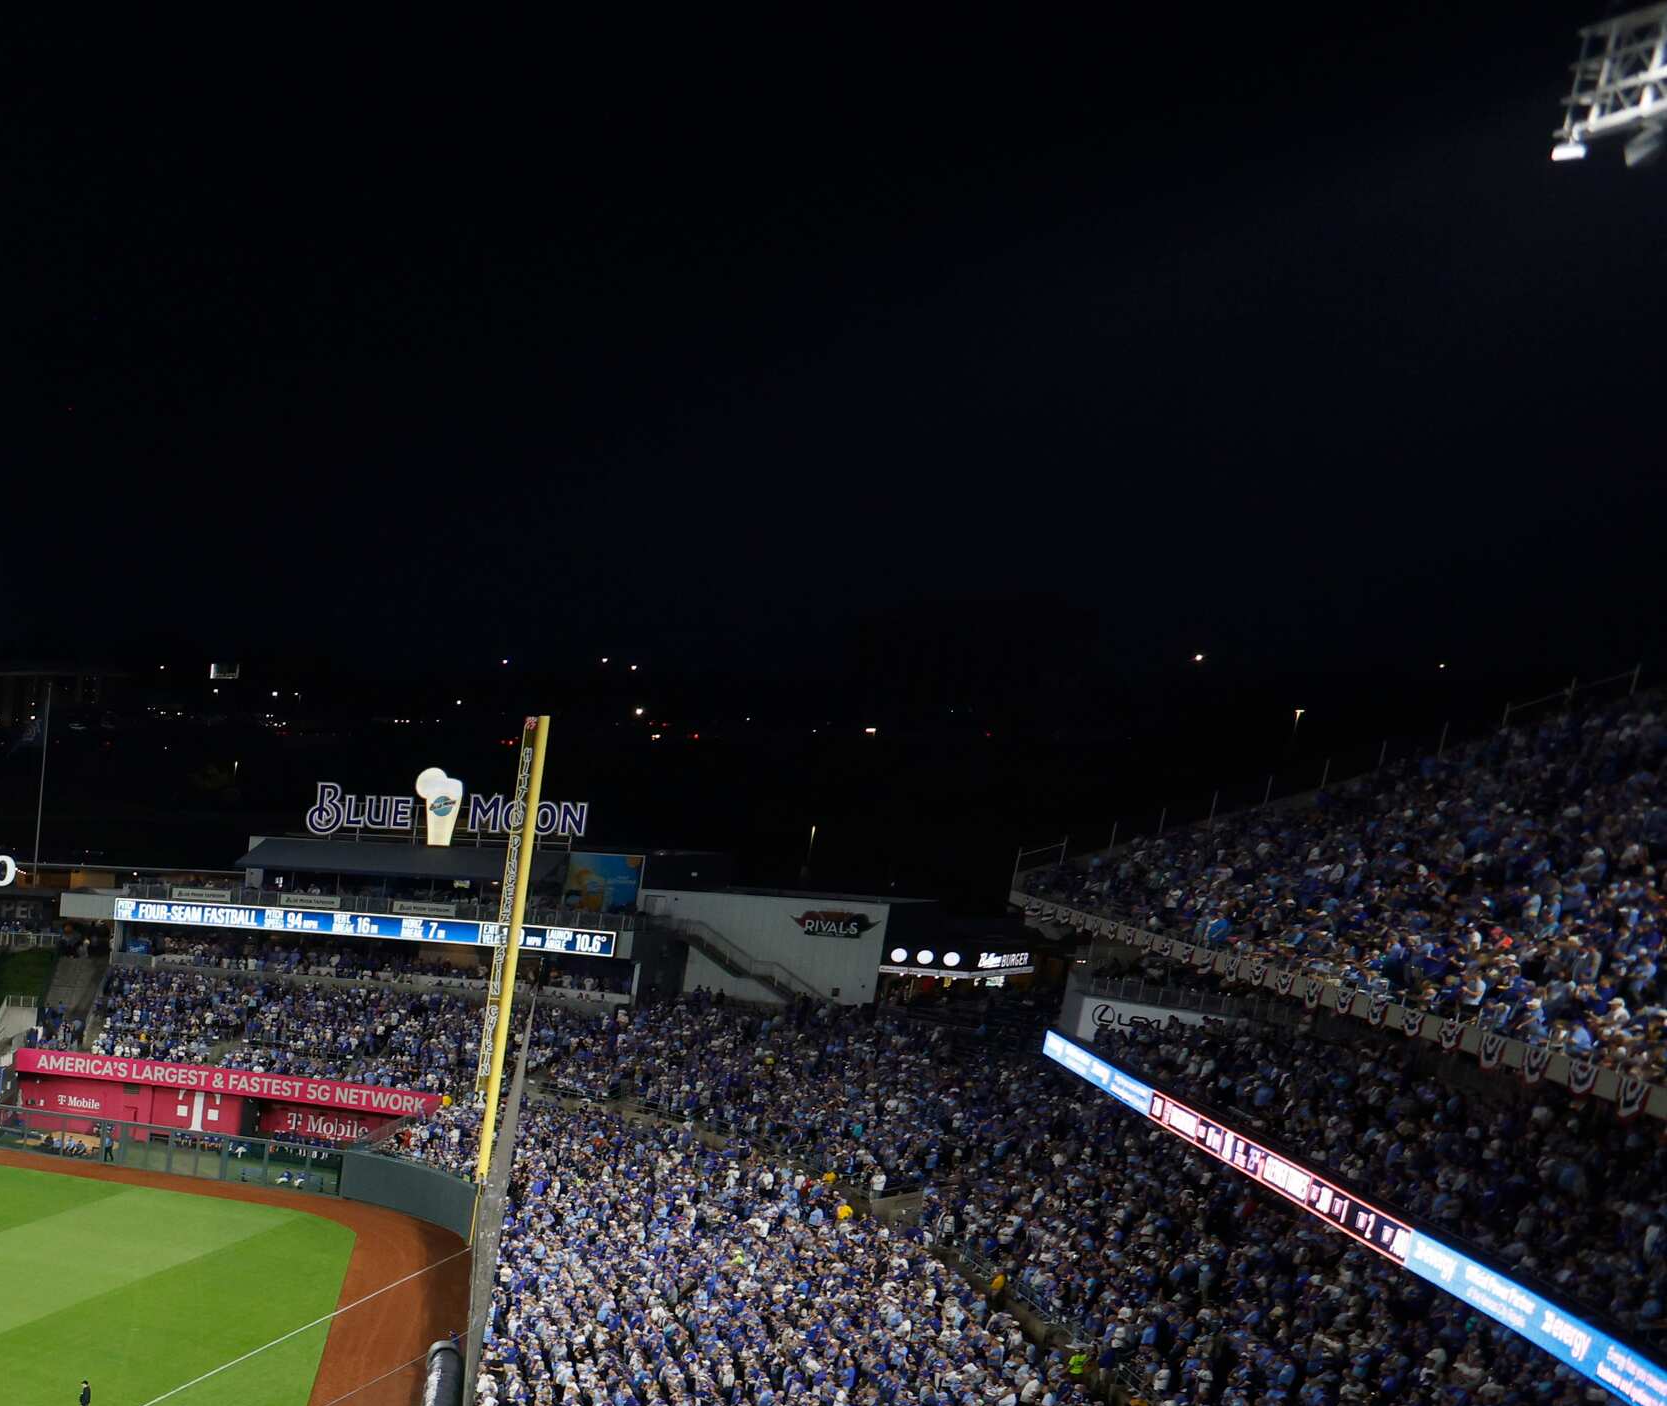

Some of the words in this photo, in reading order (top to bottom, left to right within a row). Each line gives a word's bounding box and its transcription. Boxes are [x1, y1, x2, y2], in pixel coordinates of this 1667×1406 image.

[306, 782, 413, 834] BLUE
[118, 901, 134, 910] PITCH
[139, 904, 199, 920] FOUR-SEAM
[204, 909, 257, 926] FASTBALL
[287, 912, 302, 928] 94
[357, 918, 370, 933] 16
[429, 922, 438, 938] 7
[805, 920, 858, 935] RIVALS
[546, 929, 573, 941] LAUNCH
[545, 939, 567, 950] ANGLE
[576, 934, 607, 952] 10.6°
[1001, 953, 1028, 967] BURGER
[36, 1053, 128, 1083] AMERICA'S
[131, 1065, 208, 1090] LARGEST
[212, 1073, 224, 1088] &
[228, 1075, 303, 1099] FASTEST
[306, 1082, 331, 1099] 5G
[335, 1085, 426, 1113] NETWORK
[67, 1096, 100, 1110] Mobile
[307, 1115, 368, 1138] Mobile
